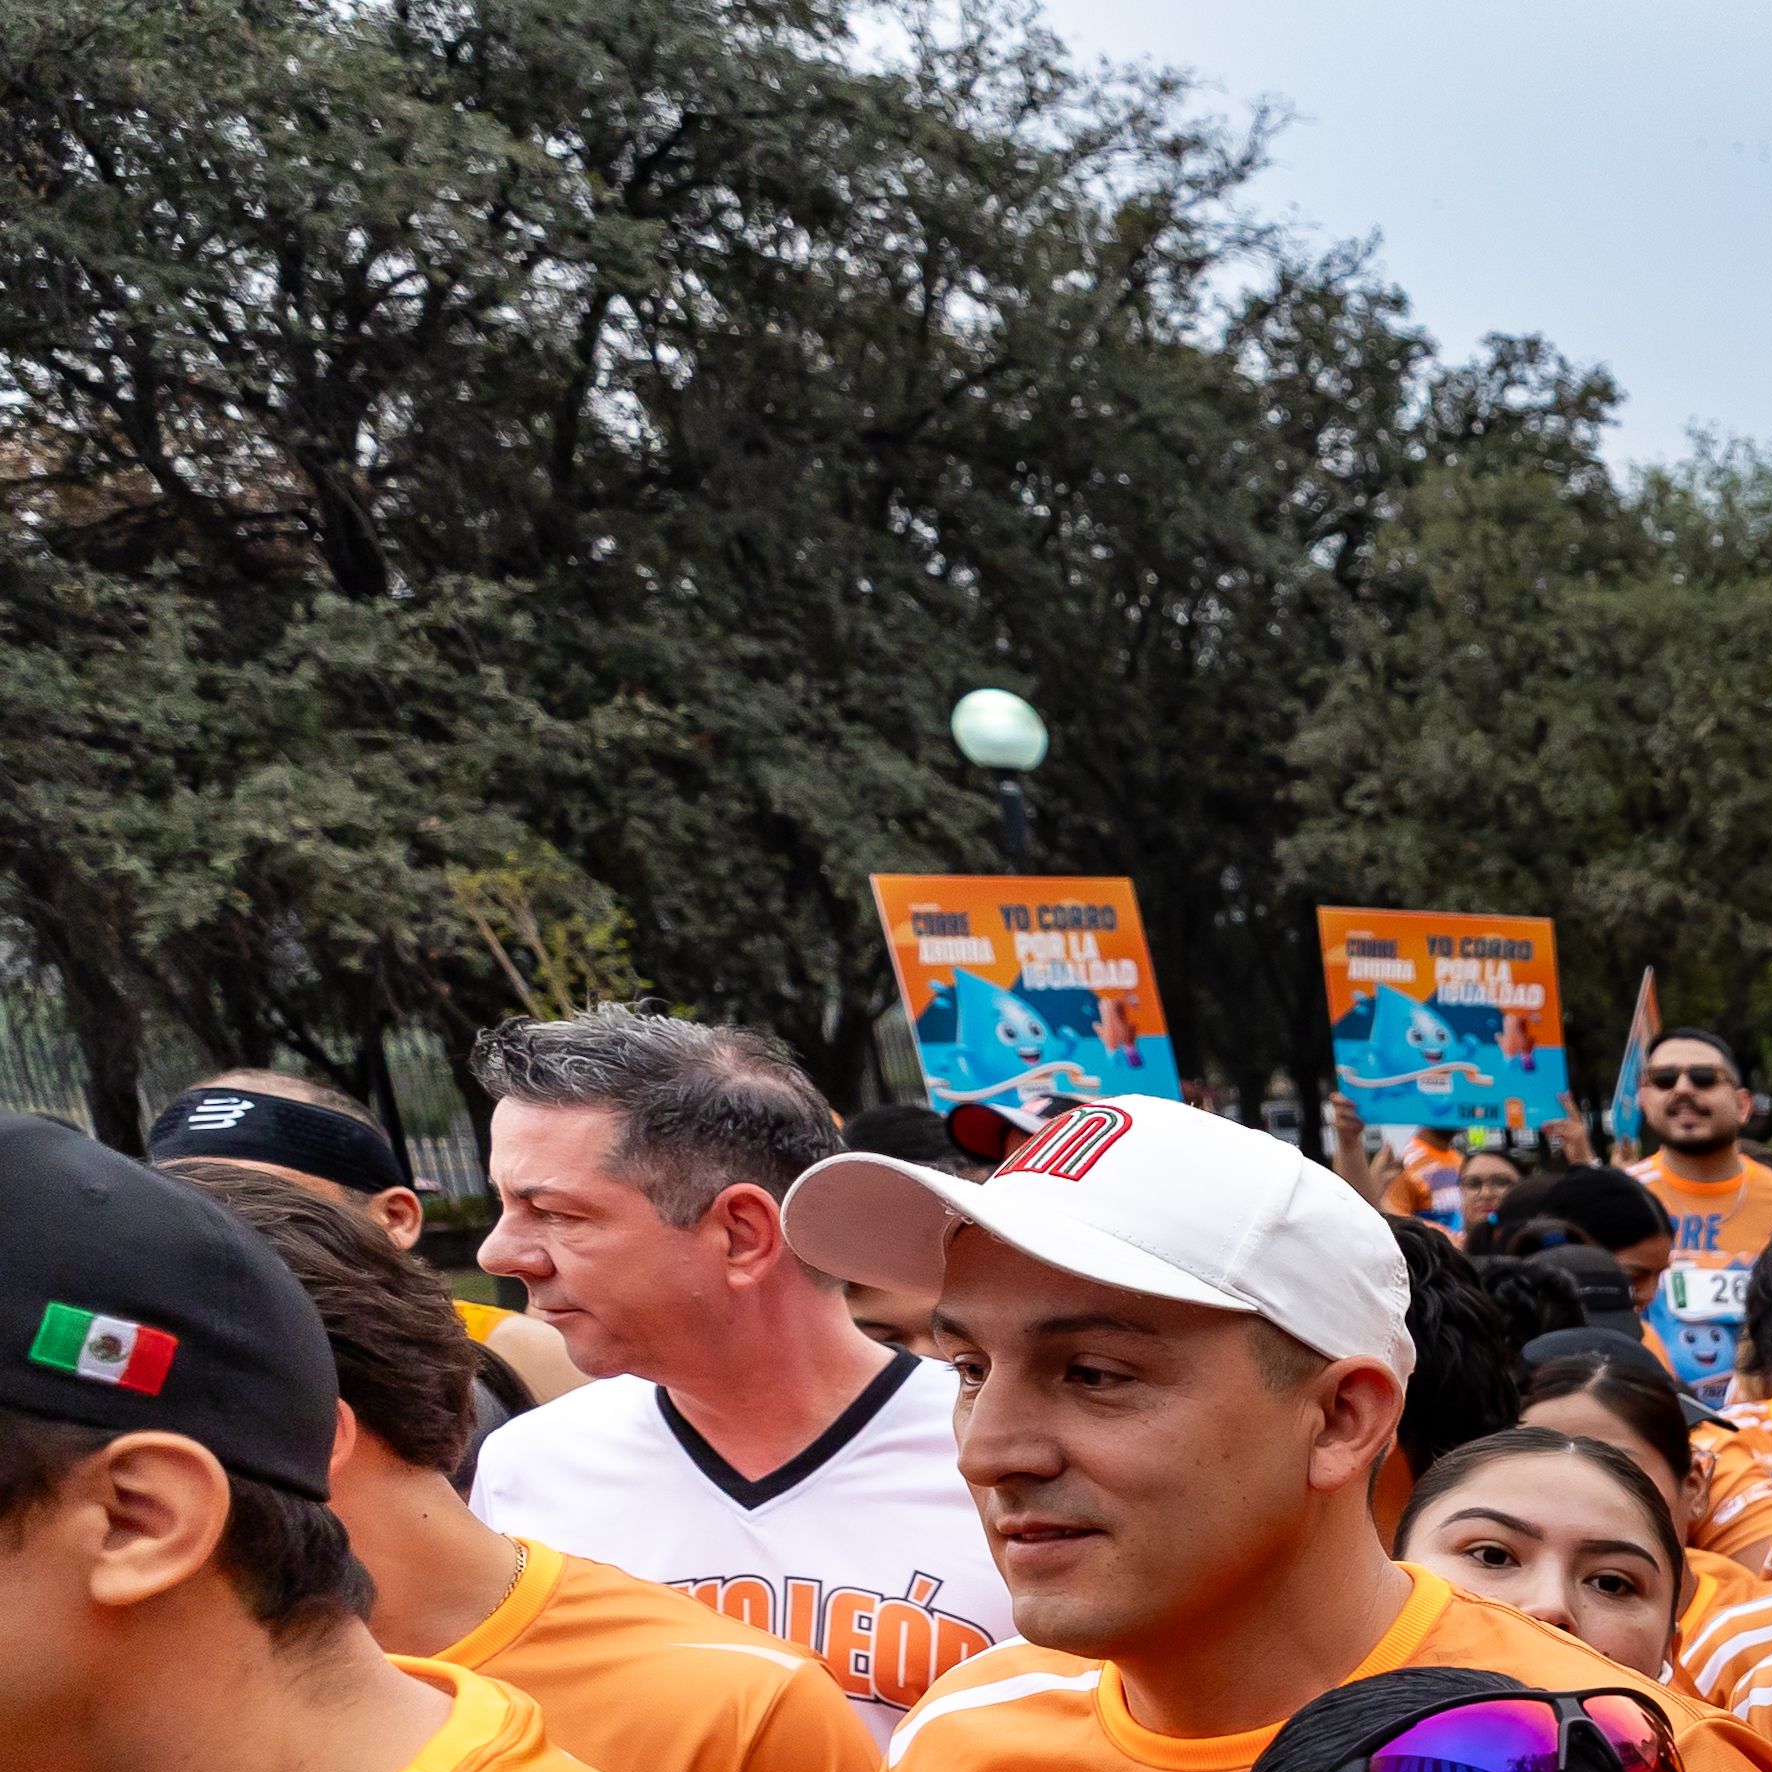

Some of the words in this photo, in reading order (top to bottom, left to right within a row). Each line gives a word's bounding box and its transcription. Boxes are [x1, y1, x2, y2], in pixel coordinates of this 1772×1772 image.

[1000, 904, 1030, 931] YO
[1036, 905, 1117, 931] CORRO
[1068, 932, 1101, 961] LA
[1427, 934, 1453, 957] YO
[1459, 936, 1534, 960] CORRO
